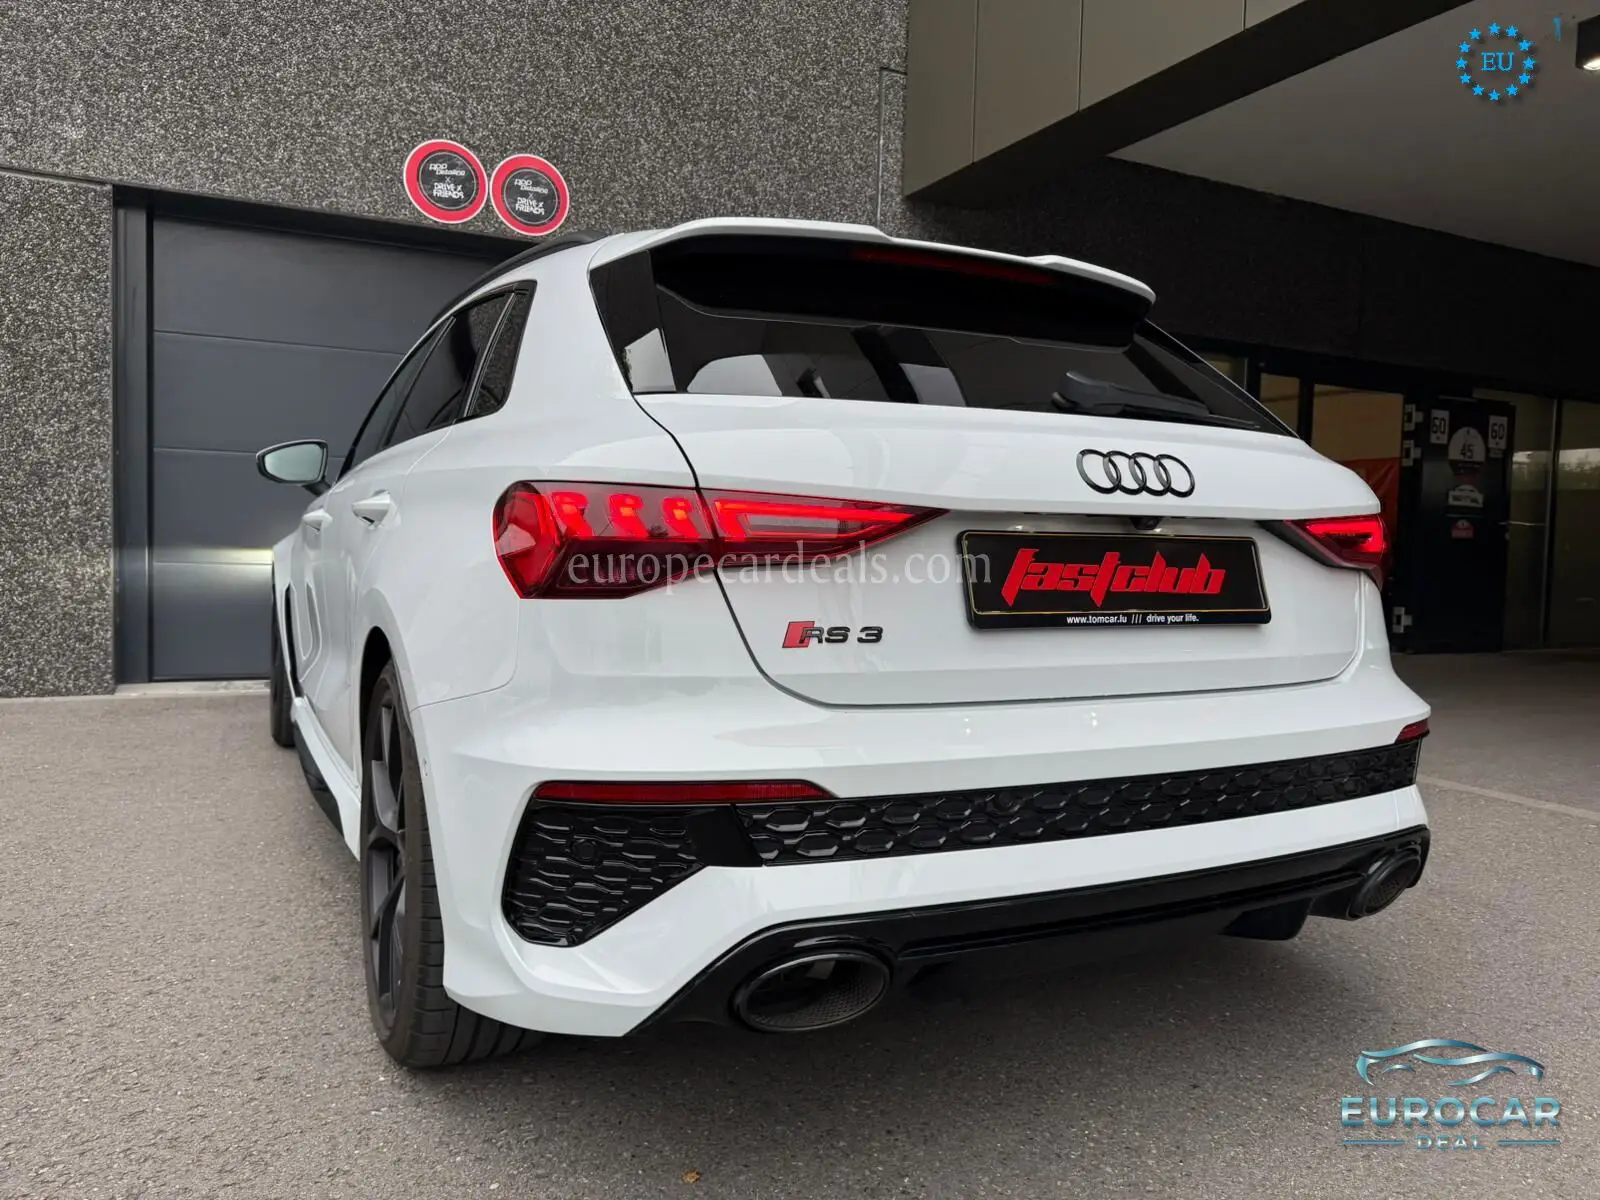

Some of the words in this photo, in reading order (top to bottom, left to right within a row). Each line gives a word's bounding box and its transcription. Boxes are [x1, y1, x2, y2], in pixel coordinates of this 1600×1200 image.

[433, 182, 455, 191] DRIVE
[433, 189, 464, 199] FRIENDS
[517, 196, 537, 206] DRIVE
[516, 204, 545, 215] FRIENDS
[1431, 417, 1446, 434] 60
[1491, 423, 1505, 440] 60
[1460, 441, 1474, 459] 45
[1066, 615, 1128, 624] www.tomcar.lu
[1146, 613, 1166, 623] drive
[1166, 614, 1183, 624] your
[1184, 612, 1199, 622] life.
[798, 625, 852, 645] RS
[857, 625, 884, 645] 3
